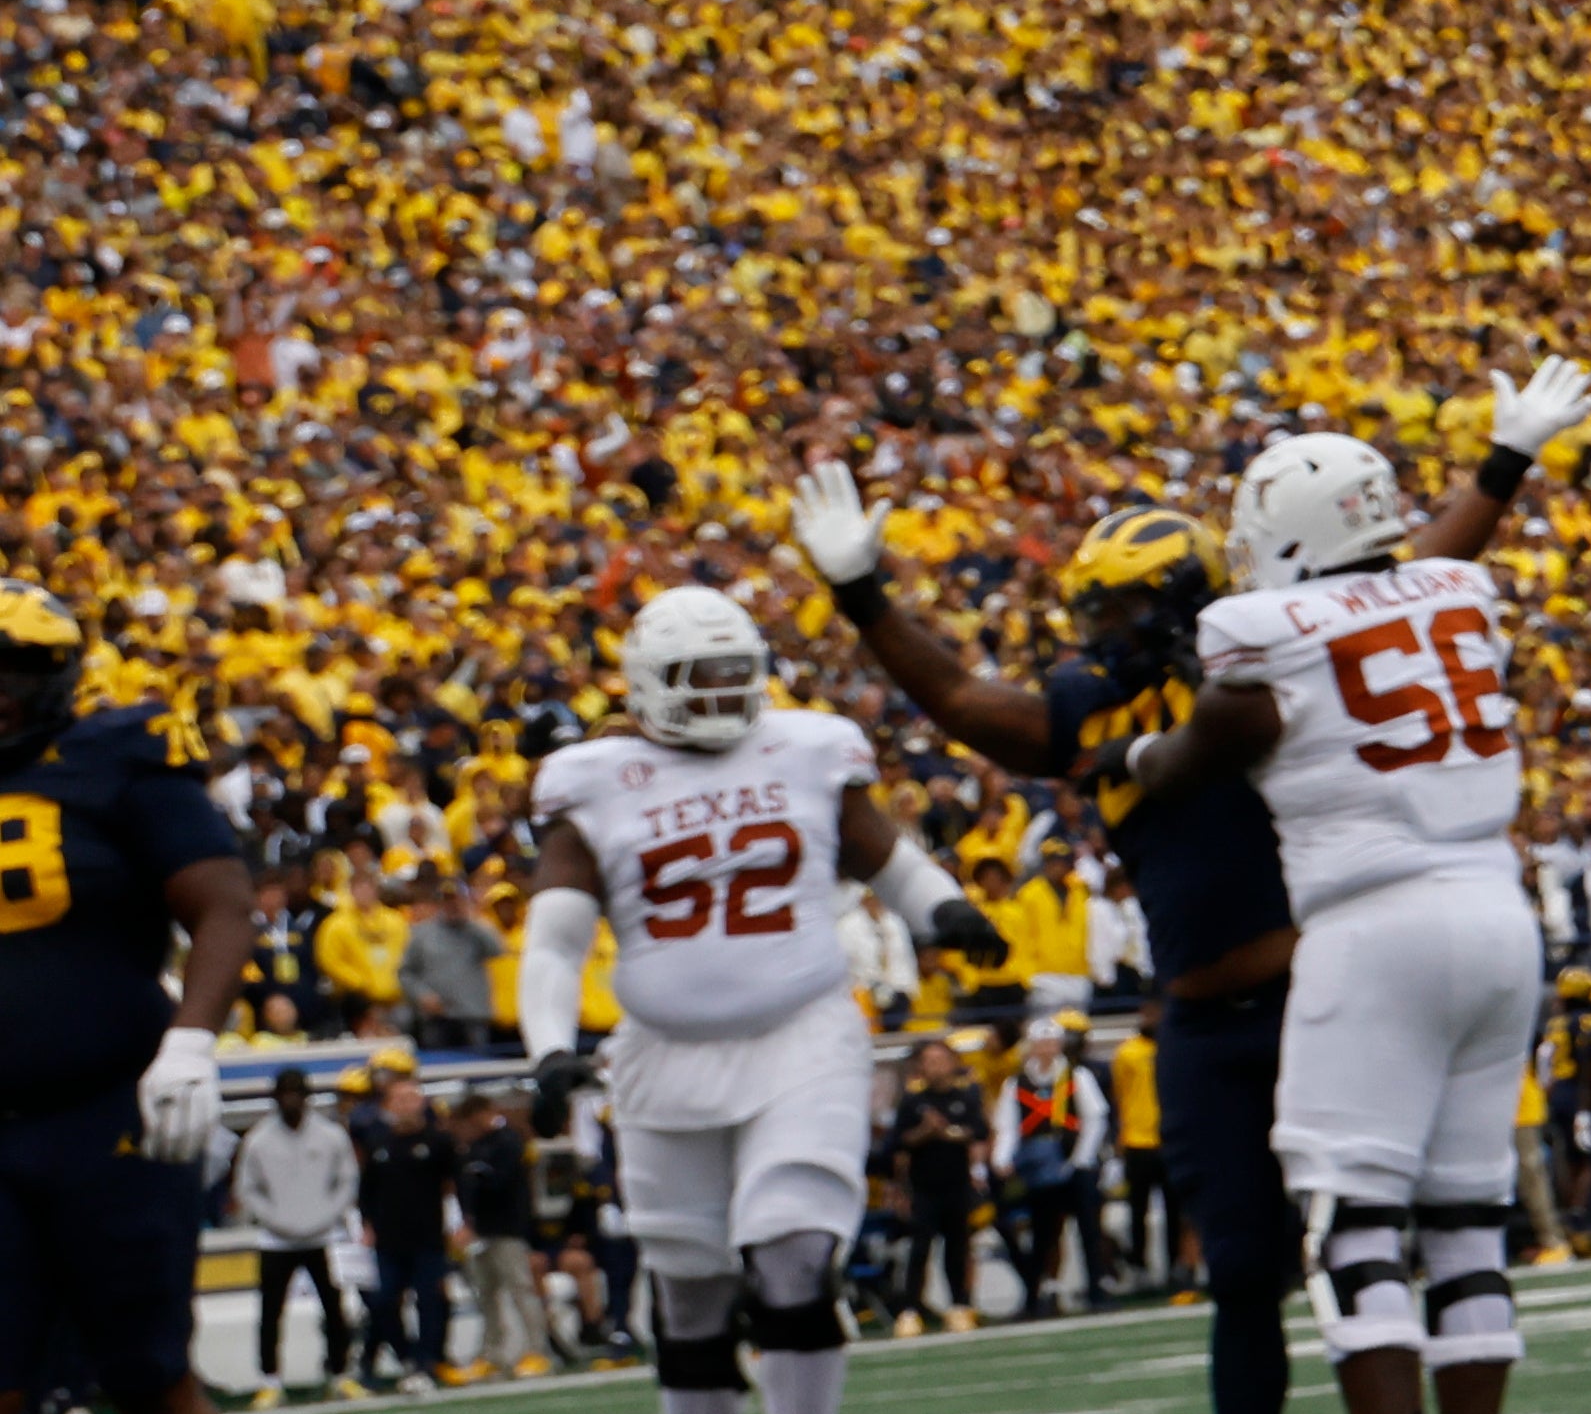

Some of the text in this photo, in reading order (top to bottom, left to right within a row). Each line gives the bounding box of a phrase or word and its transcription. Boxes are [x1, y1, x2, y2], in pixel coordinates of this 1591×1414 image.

[1284, 568, 1484, 635] C. WILLIAM
[1326, 606, 1512, 774] 56
[641, 784, 788, 838] TEXAS
[639, 819, 804, 939] 52
